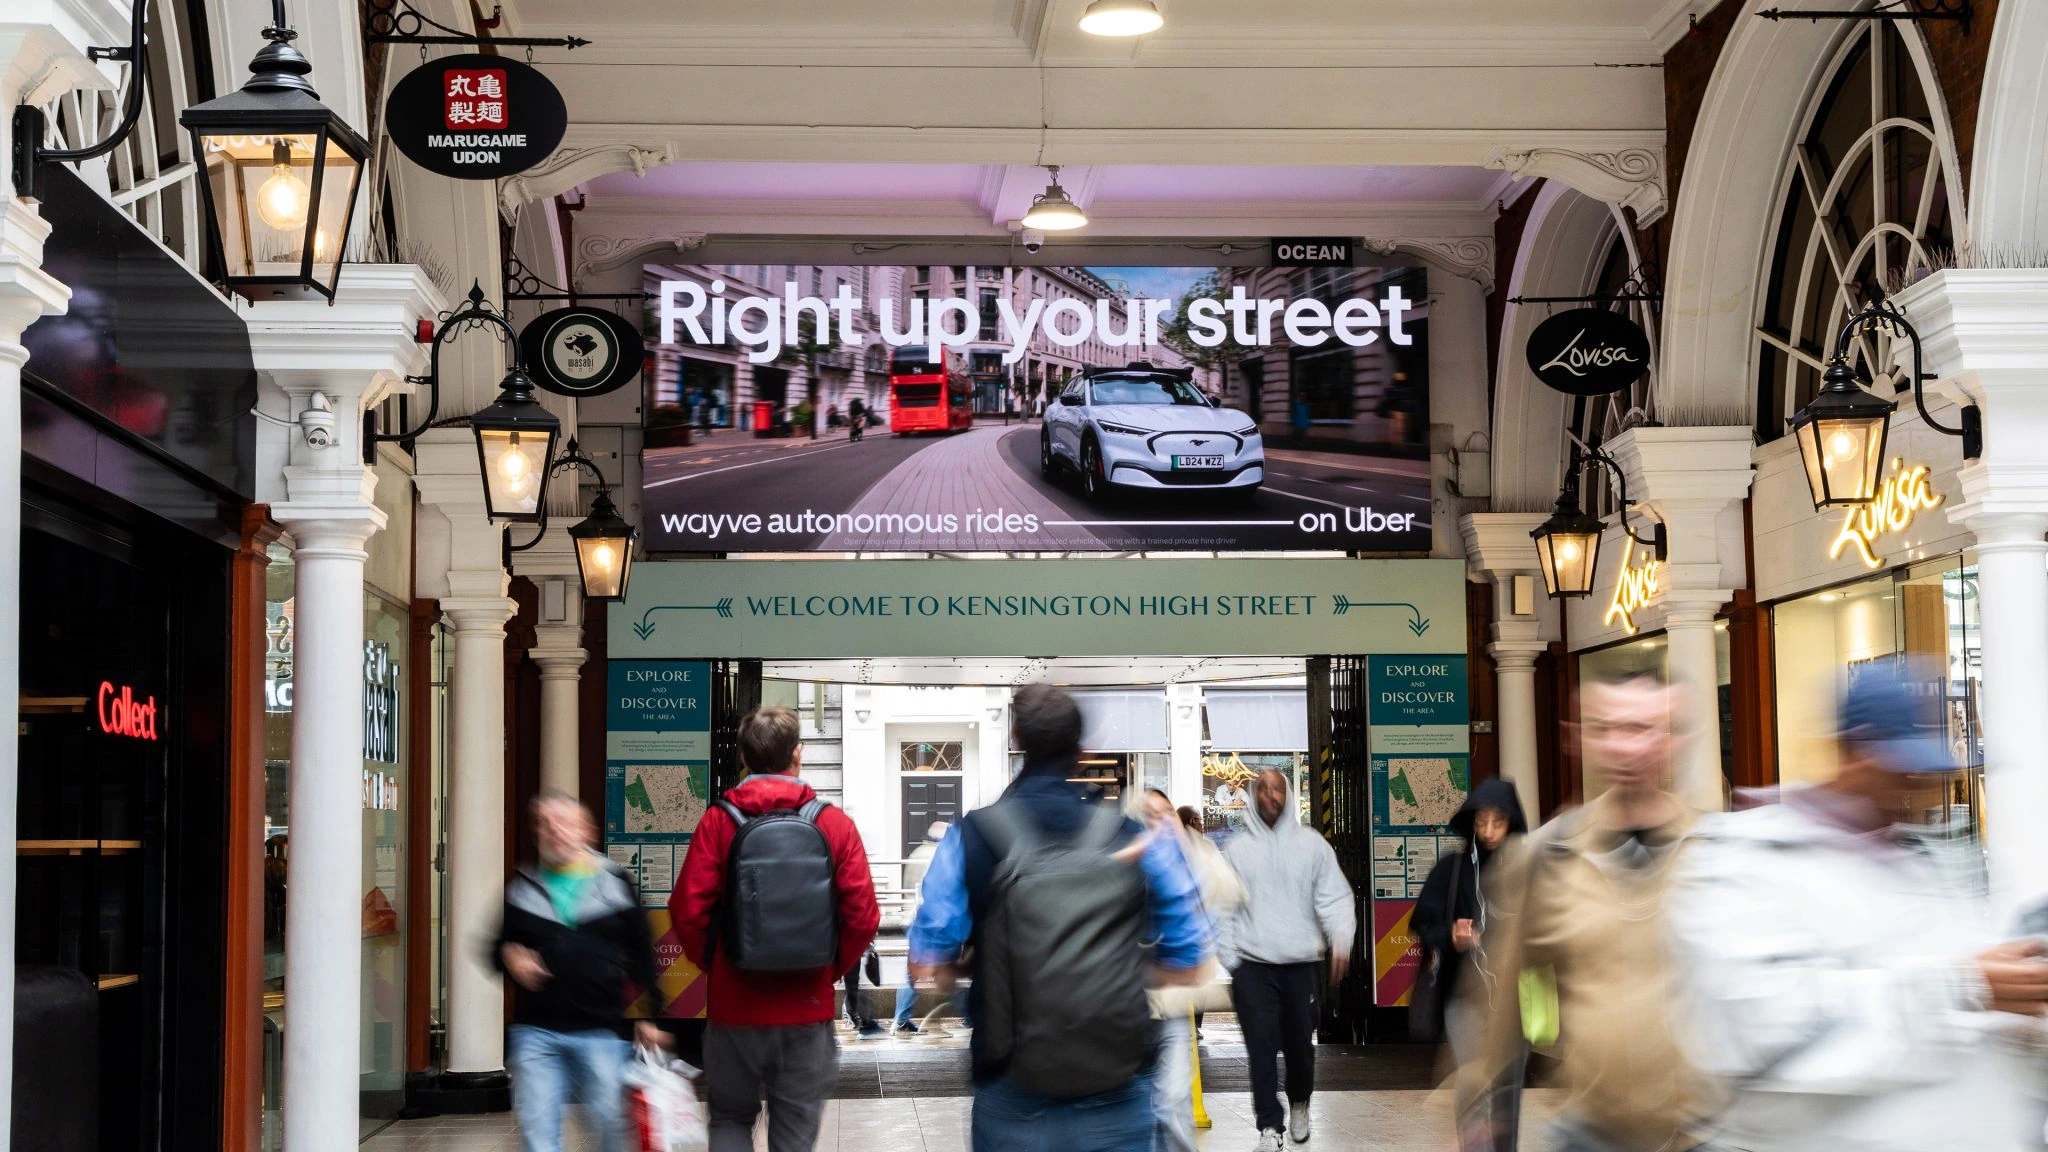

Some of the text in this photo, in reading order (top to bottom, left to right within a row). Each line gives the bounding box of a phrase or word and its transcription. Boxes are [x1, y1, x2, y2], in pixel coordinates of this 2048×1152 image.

[448, 74, 502, 98] 丸亀
[428, 134, 527, 147] MARUGAME
[452, 151, 500, 164] UDON
[1277, 244, 1345, 260] OCEAN
[660, 279, 1413, 364] Right up your street
[1539, 327, 1640, 377] Lovisa
[567, 356, 594, 368] wasabi
[1179, 456, 1223, 467] LD24 WZZ
[1830, 430, 1946, 569] Lovisa
[660, 506, 1416, 539] wayve autonomous rides on Uber
[1068, 537, 1094, 545] vehicle
[1125, 537, 1140, 545] with
[1147, 537, 1173, 545] trained
[1174, 537, 1199, 547] private
[1201, 537, 1214, 545] hire
[1215, 537, 1236, 545] driver
[747, 595, 1317, 616] WELCOME TO KENSINGTON HIGH STREET
[627, 670, 692, 682] EXPLORE
[1386, 665, 1449, 676] EXPLORE
[621, 698, 697, 709] DISCOVER
[1382, 692, 1455, 703] DISCOVER
[98, 680, 158, 741] Collect
[1404, 948, 1424, 957] ARC
[656, 957, 677, 966] ADE
